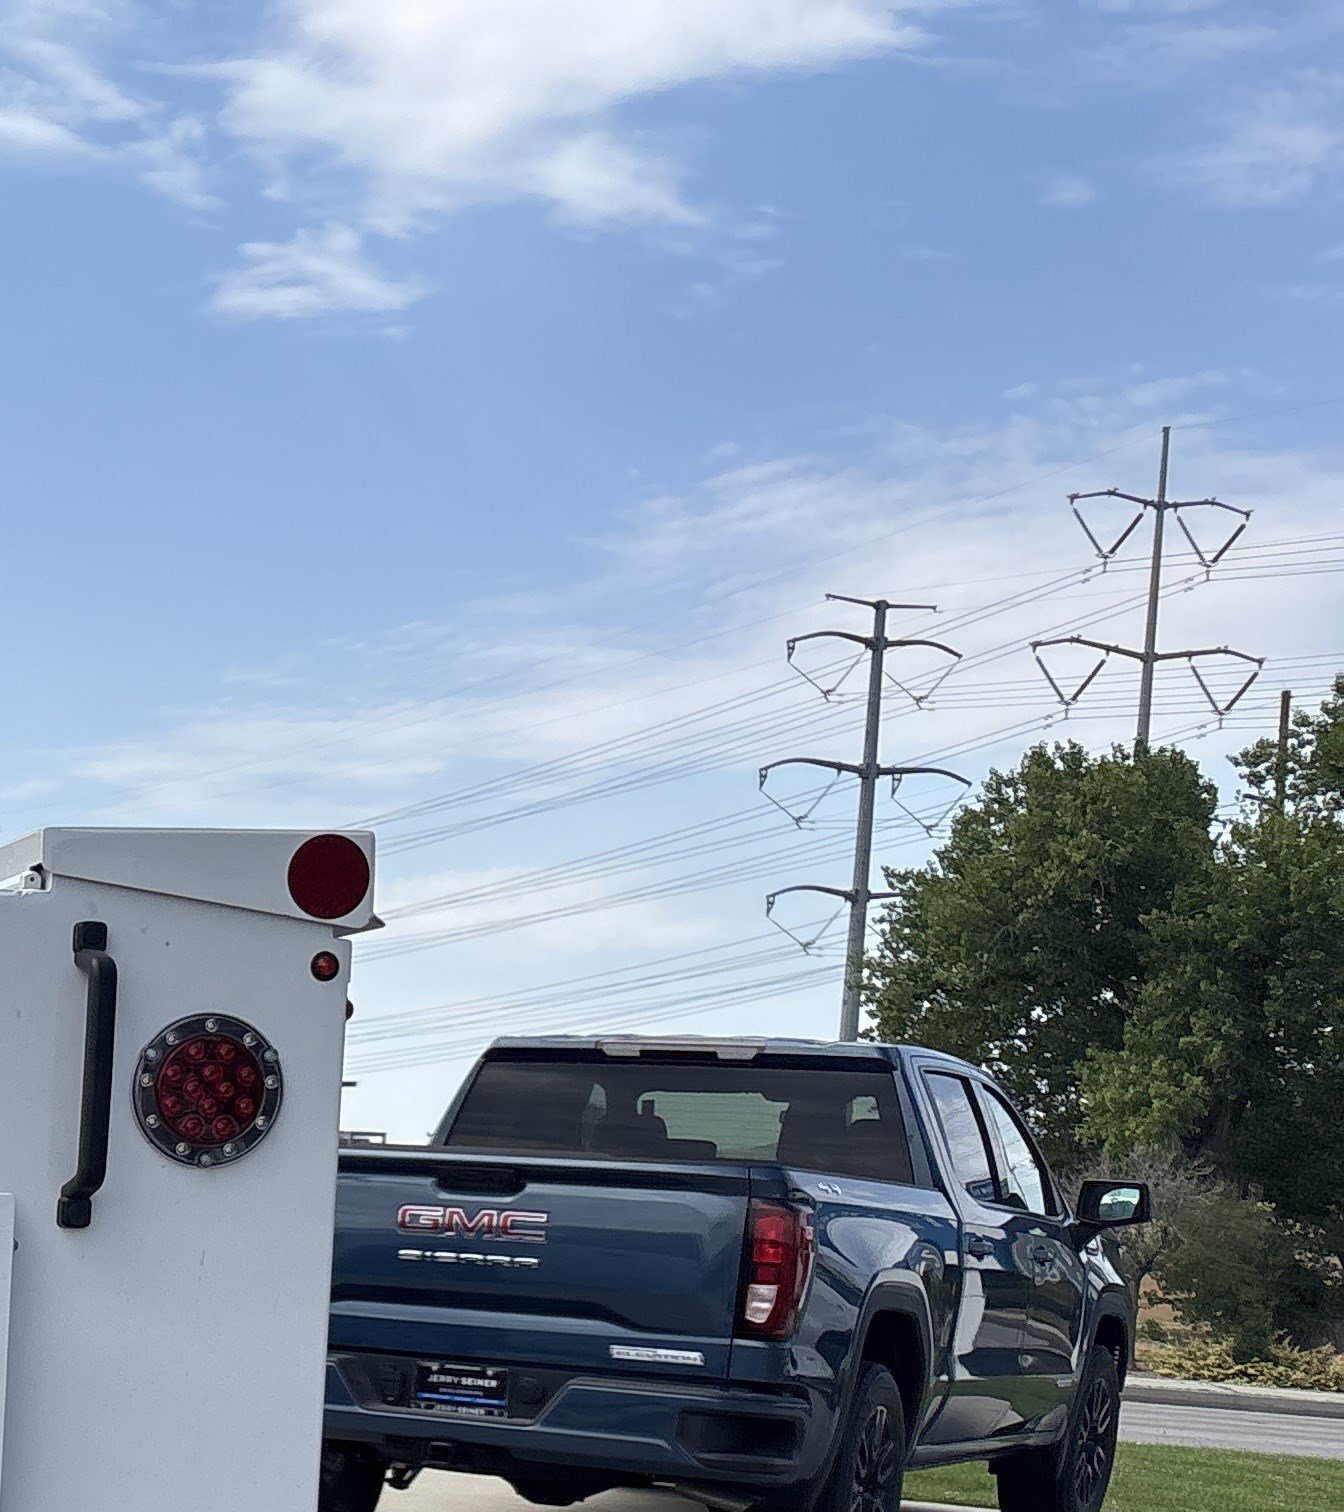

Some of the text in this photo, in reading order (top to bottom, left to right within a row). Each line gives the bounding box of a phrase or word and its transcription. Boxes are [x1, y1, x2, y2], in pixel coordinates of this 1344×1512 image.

[397, 1204, 548, 1243] GMC
[397, 1249, 540, 1269] SIERRA
[460, 1376, 498, 1388] SEINER
